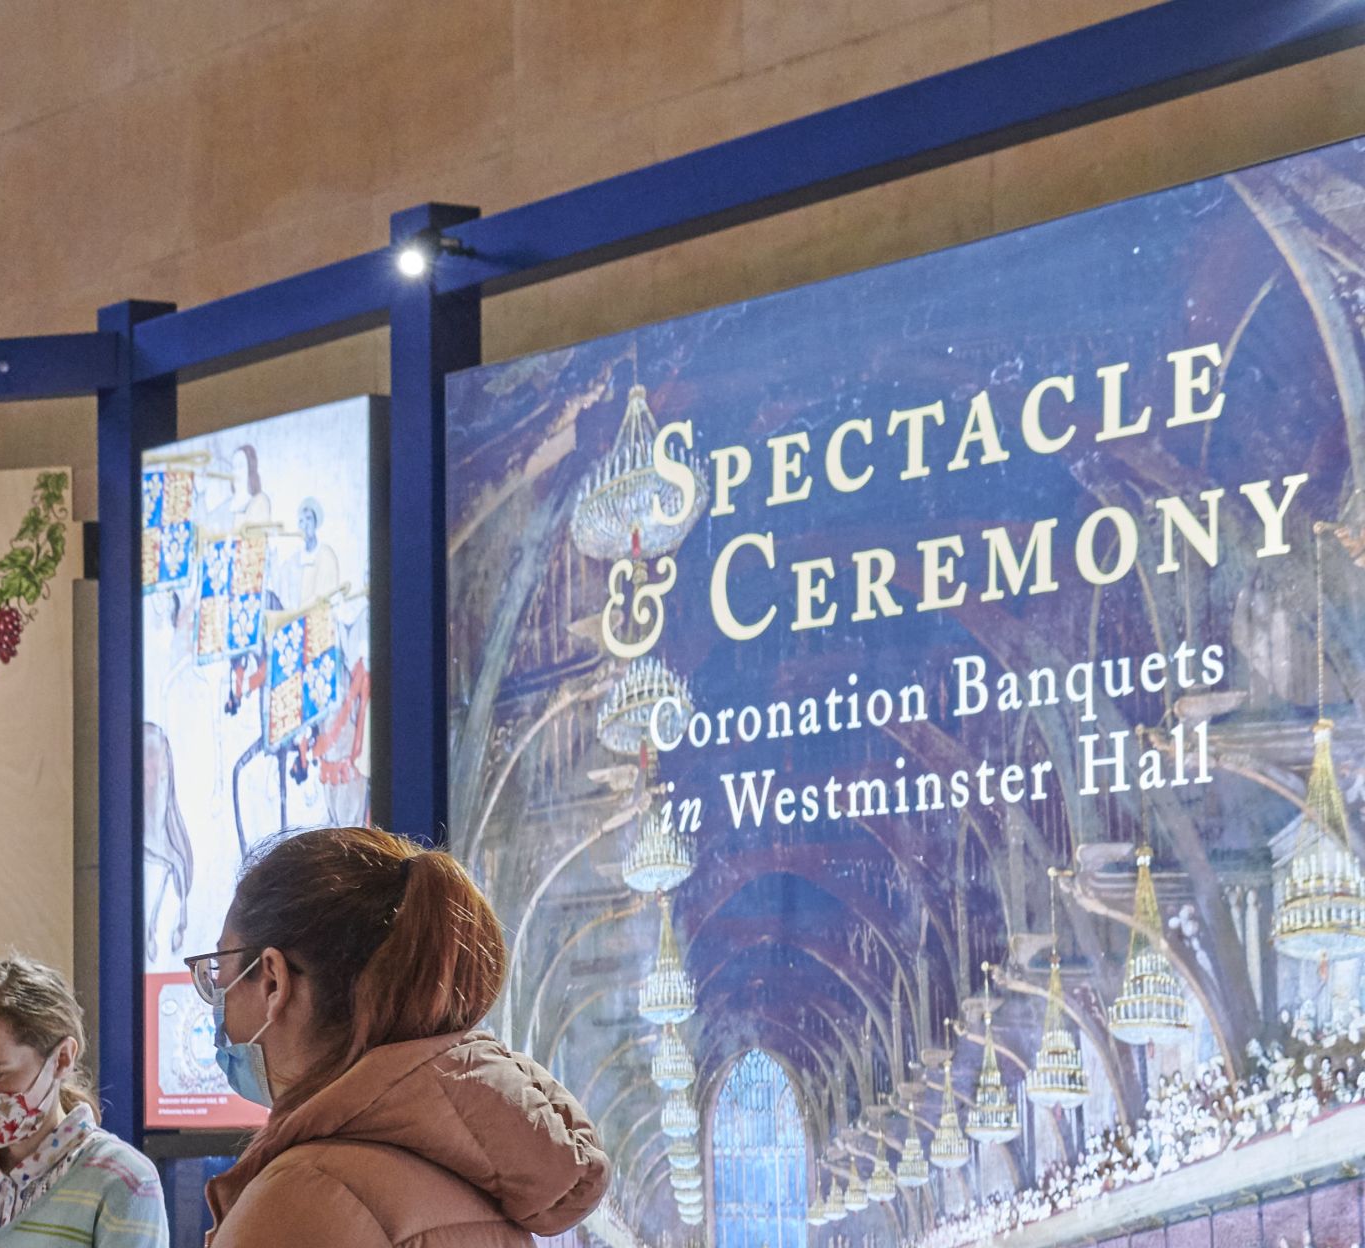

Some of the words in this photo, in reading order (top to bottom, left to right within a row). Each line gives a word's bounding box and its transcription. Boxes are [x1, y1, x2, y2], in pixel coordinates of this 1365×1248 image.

[651, 342, 1226, 526] SPECTACLE
[601, 555, 676, 657] &
[711, 472, 1309, 641] CEREMONY
[649, 672, 926, 751] Coronation
[953, 641, 1225, 722] Banquets
[662, 782, 702, 834] in
[721, 756, 1053, 829] Westminster
[1079, 719, 1213, 796] Hall
